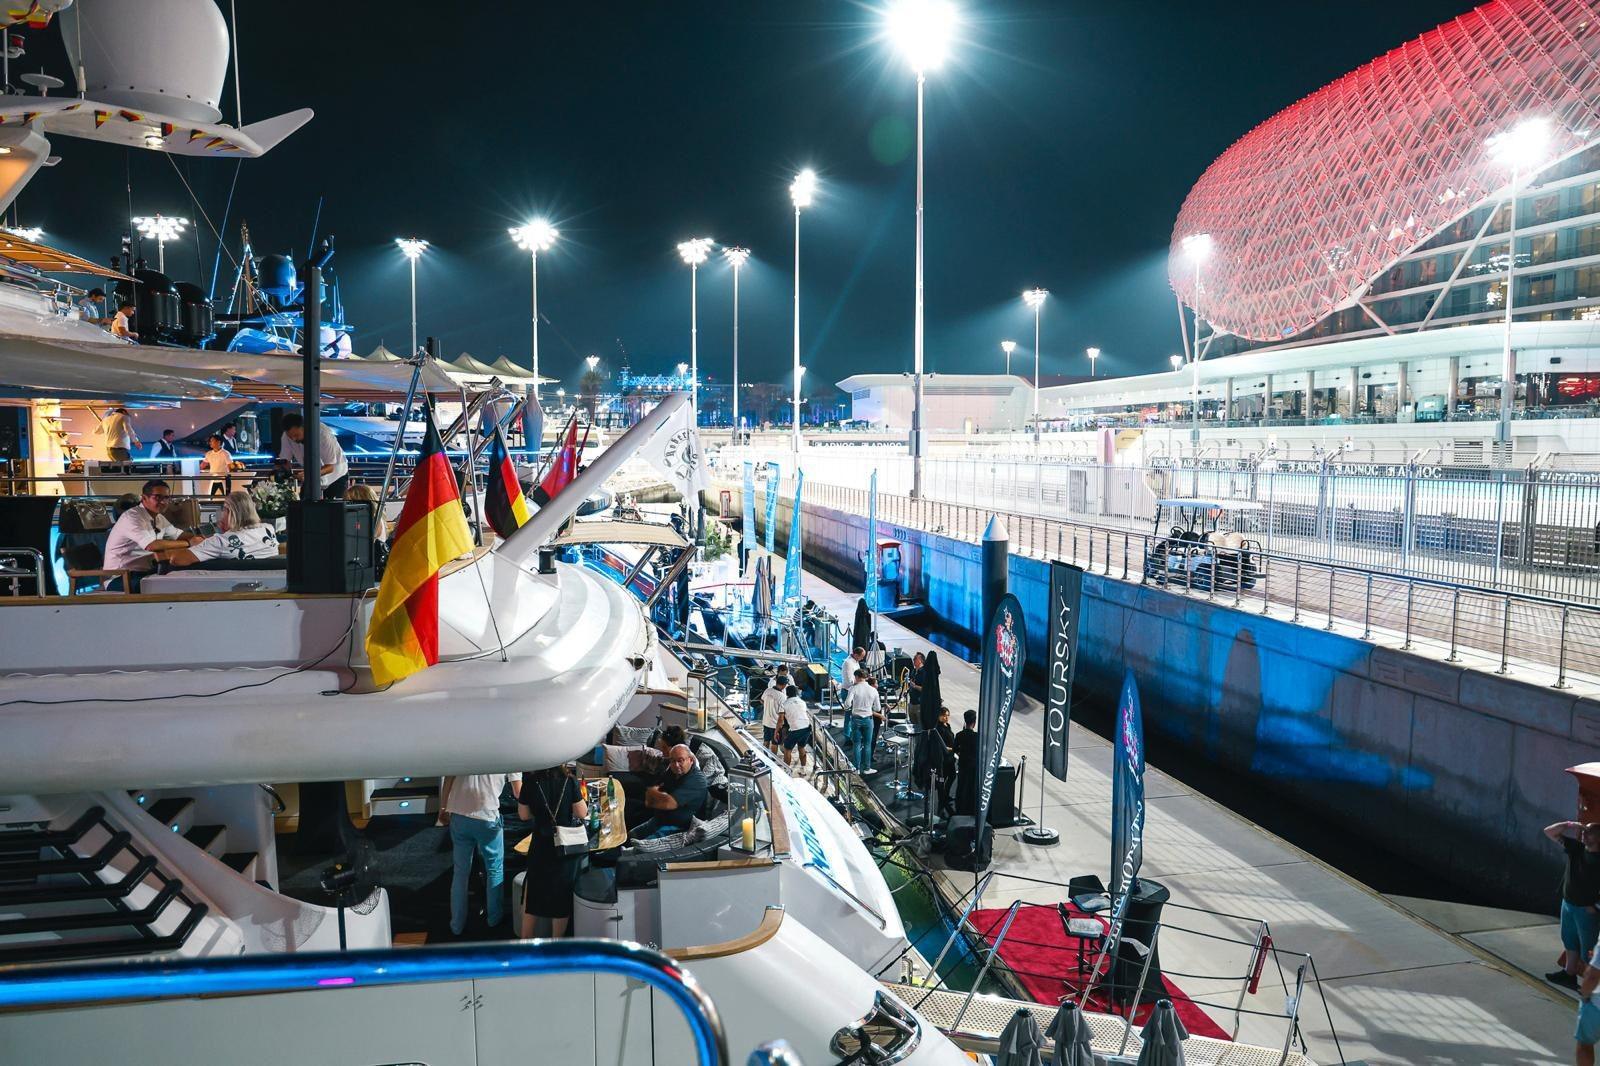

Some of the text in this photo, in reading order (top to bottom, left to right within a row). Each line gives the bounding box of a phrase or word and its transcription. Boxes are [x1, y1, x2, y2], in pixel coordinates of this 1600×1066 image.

[1344, 464, 1379, 475] ADNOC
[1049, 596, 1071, 747] YOURSKY
[980, 771, 995, 812] GEISS
